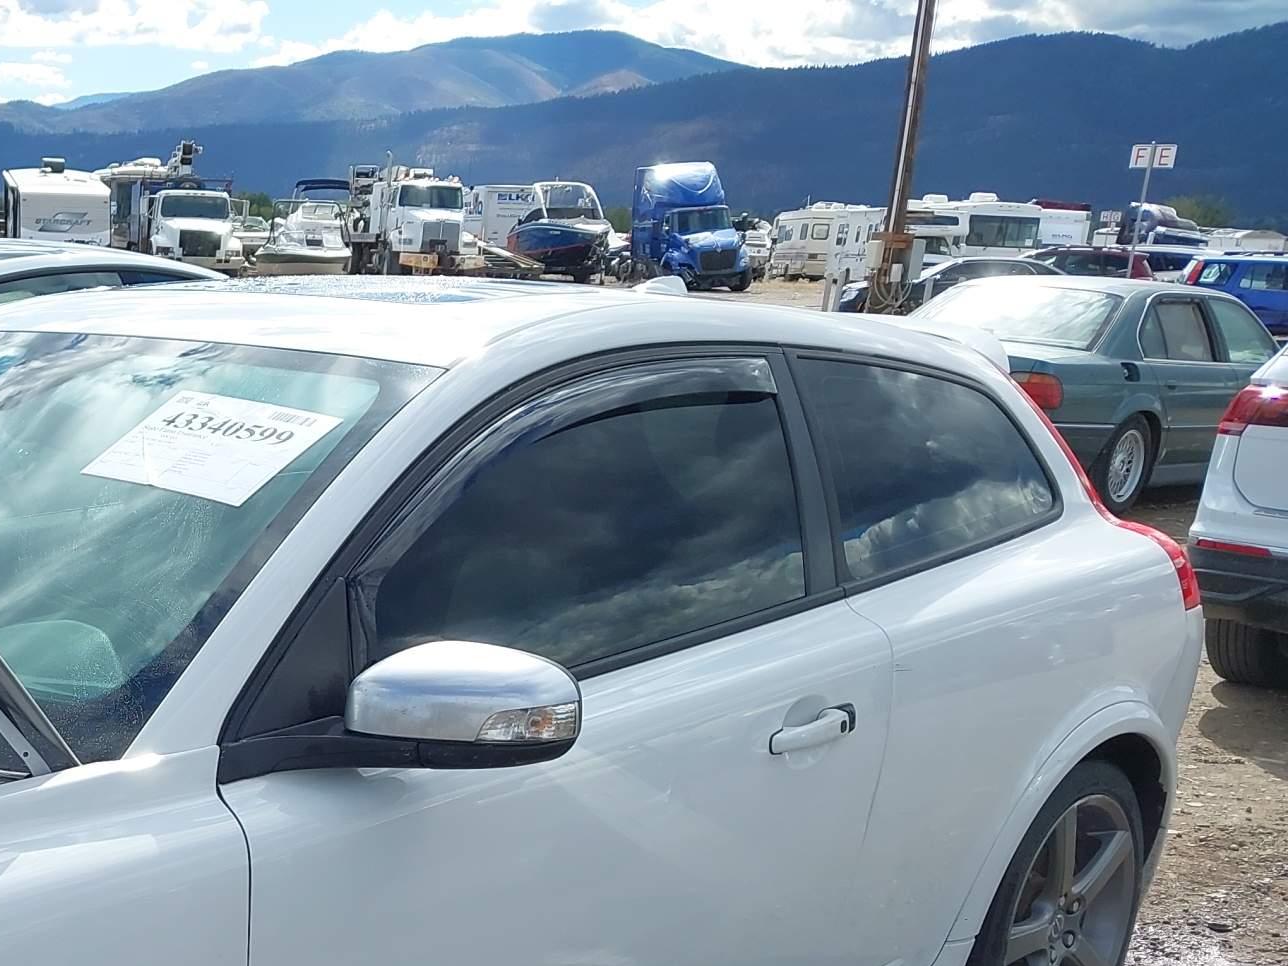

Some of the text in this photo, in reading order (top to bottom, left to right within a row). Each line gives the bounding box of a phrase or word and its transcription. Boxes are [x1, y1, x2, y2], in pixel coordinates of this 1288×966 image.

[1135, 147, 1172, 166] F E
[162, 411, 295, 446] 43340599
